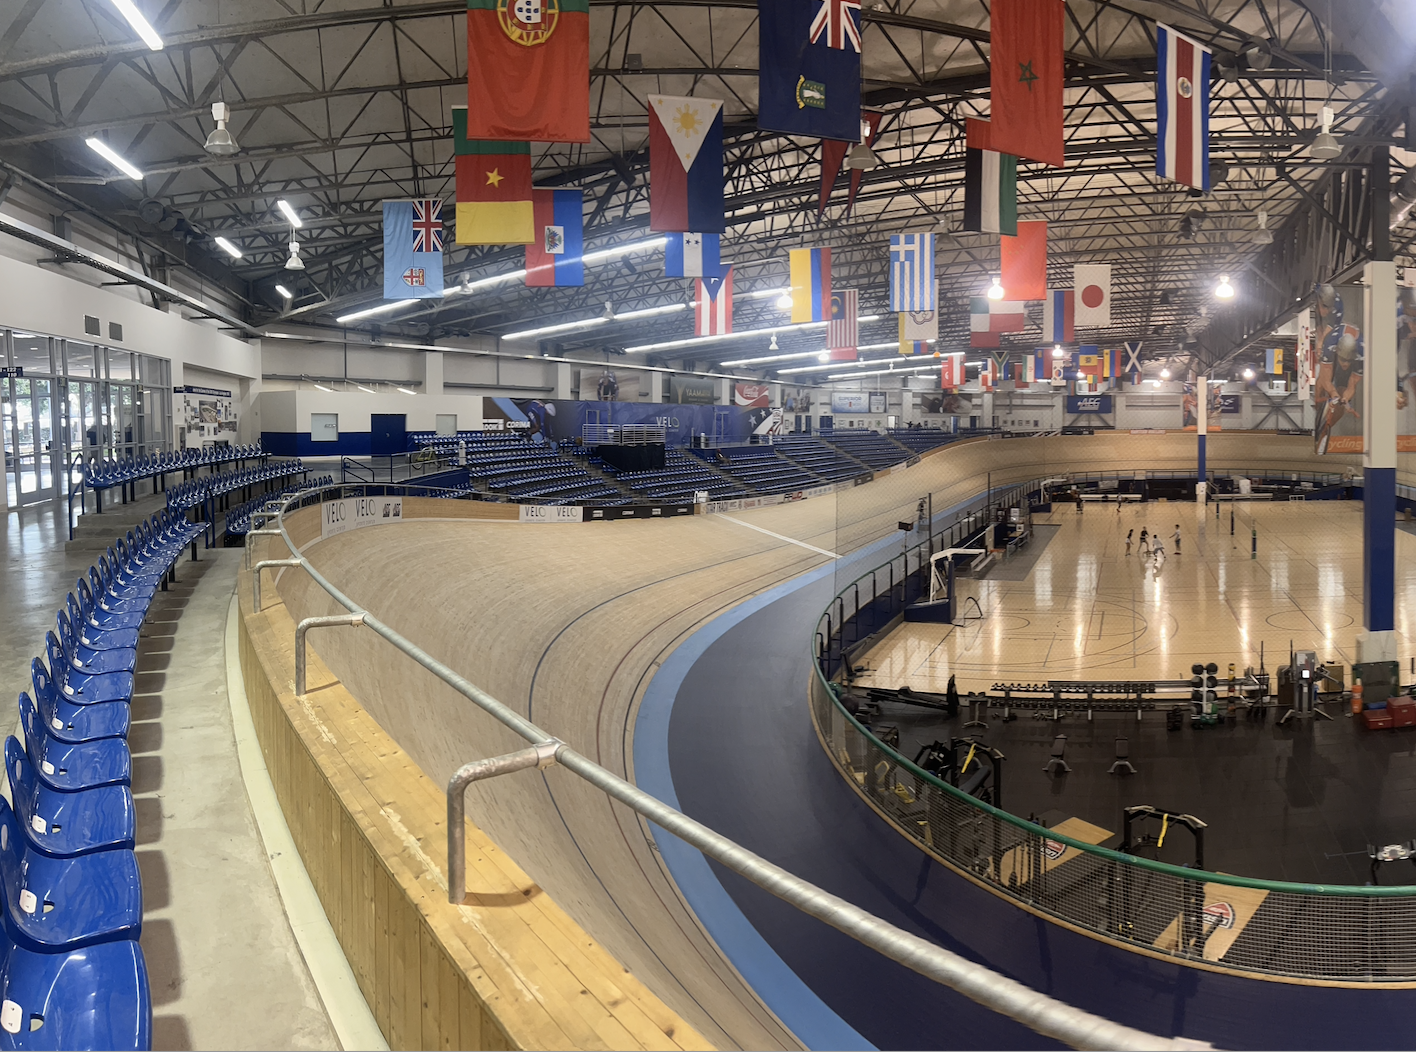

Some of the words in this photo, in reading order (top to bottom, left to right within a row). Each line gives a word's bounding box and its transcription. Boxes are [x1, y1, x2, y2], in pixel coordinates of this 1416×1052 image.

[655, 416, 680, 428] VELO
[326, 501, 347, 524] VELO
[355, 499, 377, 517] VELO
[525, 506, 547, 518] VELO
[556, 507, 578, 518] VELO
